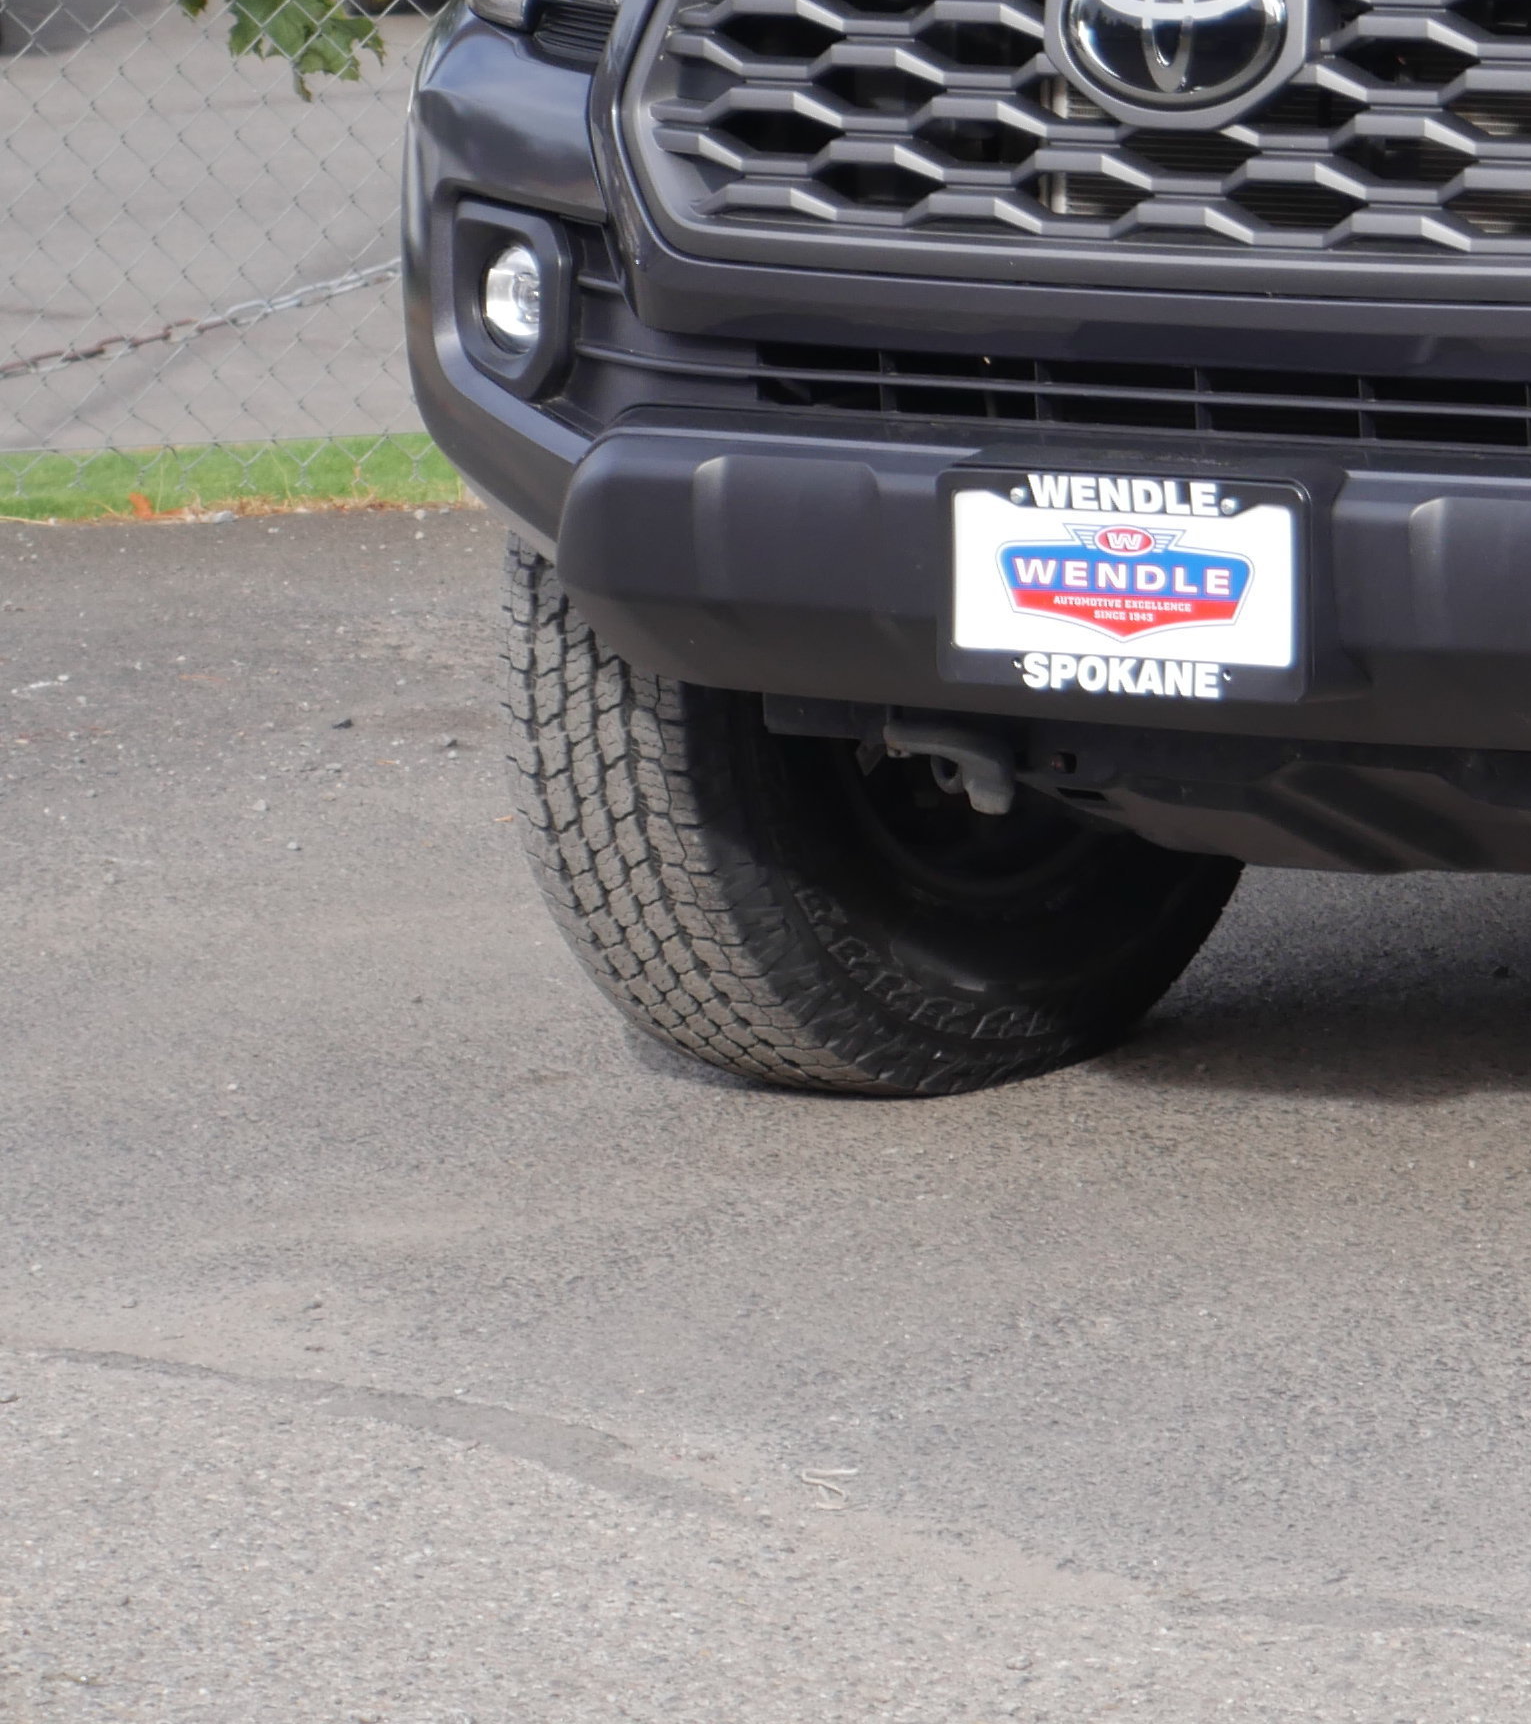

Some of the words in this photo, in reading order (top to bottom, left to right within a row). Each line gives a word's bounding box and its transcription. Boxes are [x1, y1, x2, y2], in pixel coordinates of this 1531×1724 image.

[1027, 474, 1220, 516] WENDLE
[1014, 557, 1231, 596] WENDLE
[1053, 595, 1122, 609] AUTOMOTIVE
[1125, 599, 1192, 613] EXCELLENCE
[1094, 609, 1127, 622] SINCE
[1129, 611, 1154, 623] 1943
[1022, 652, 1220, 699] SPOKANE
